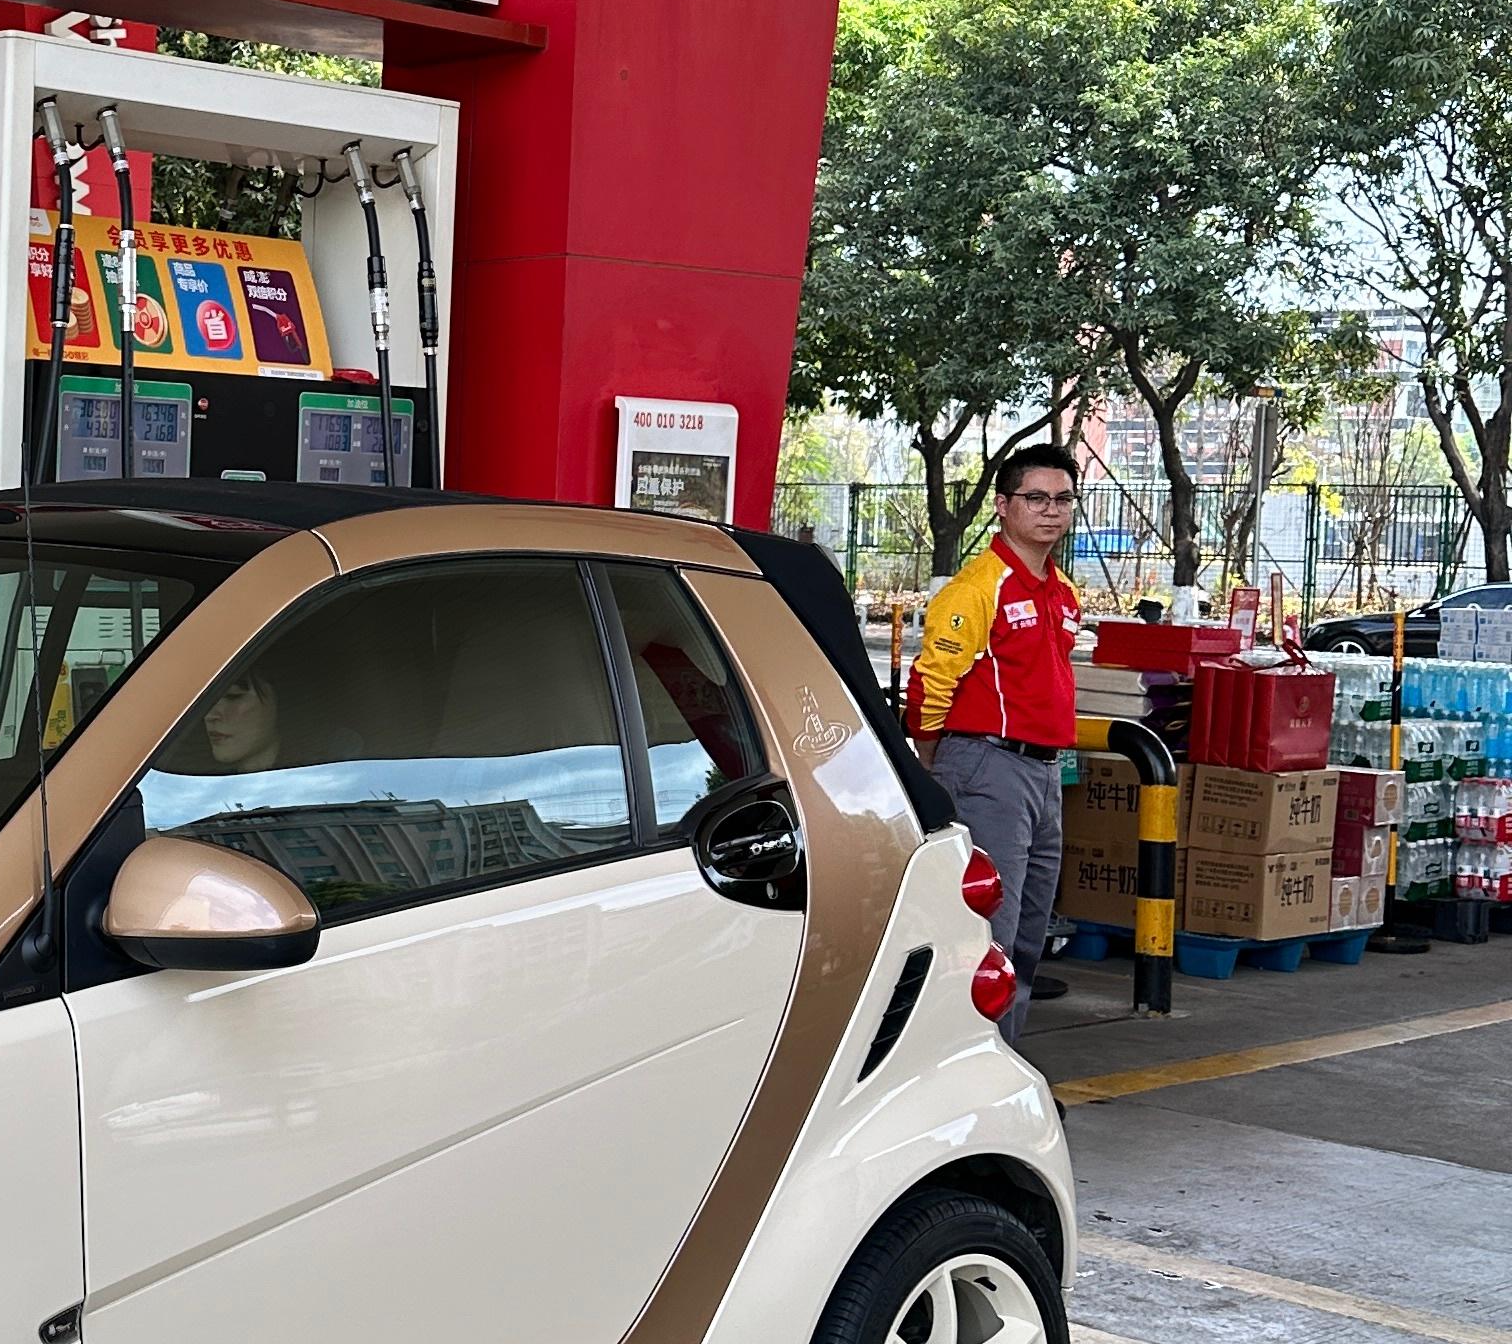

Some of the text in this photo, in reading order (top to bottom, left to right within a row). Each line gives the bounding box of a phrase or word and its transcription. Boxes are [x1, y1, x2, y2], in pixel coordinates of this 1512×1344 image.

[634, 411, 704, 431] 400 010 3218
[1289, 794, 1322, 826] 纯牛奶
[1280, 874, 1314, 907] 纯牛奶
